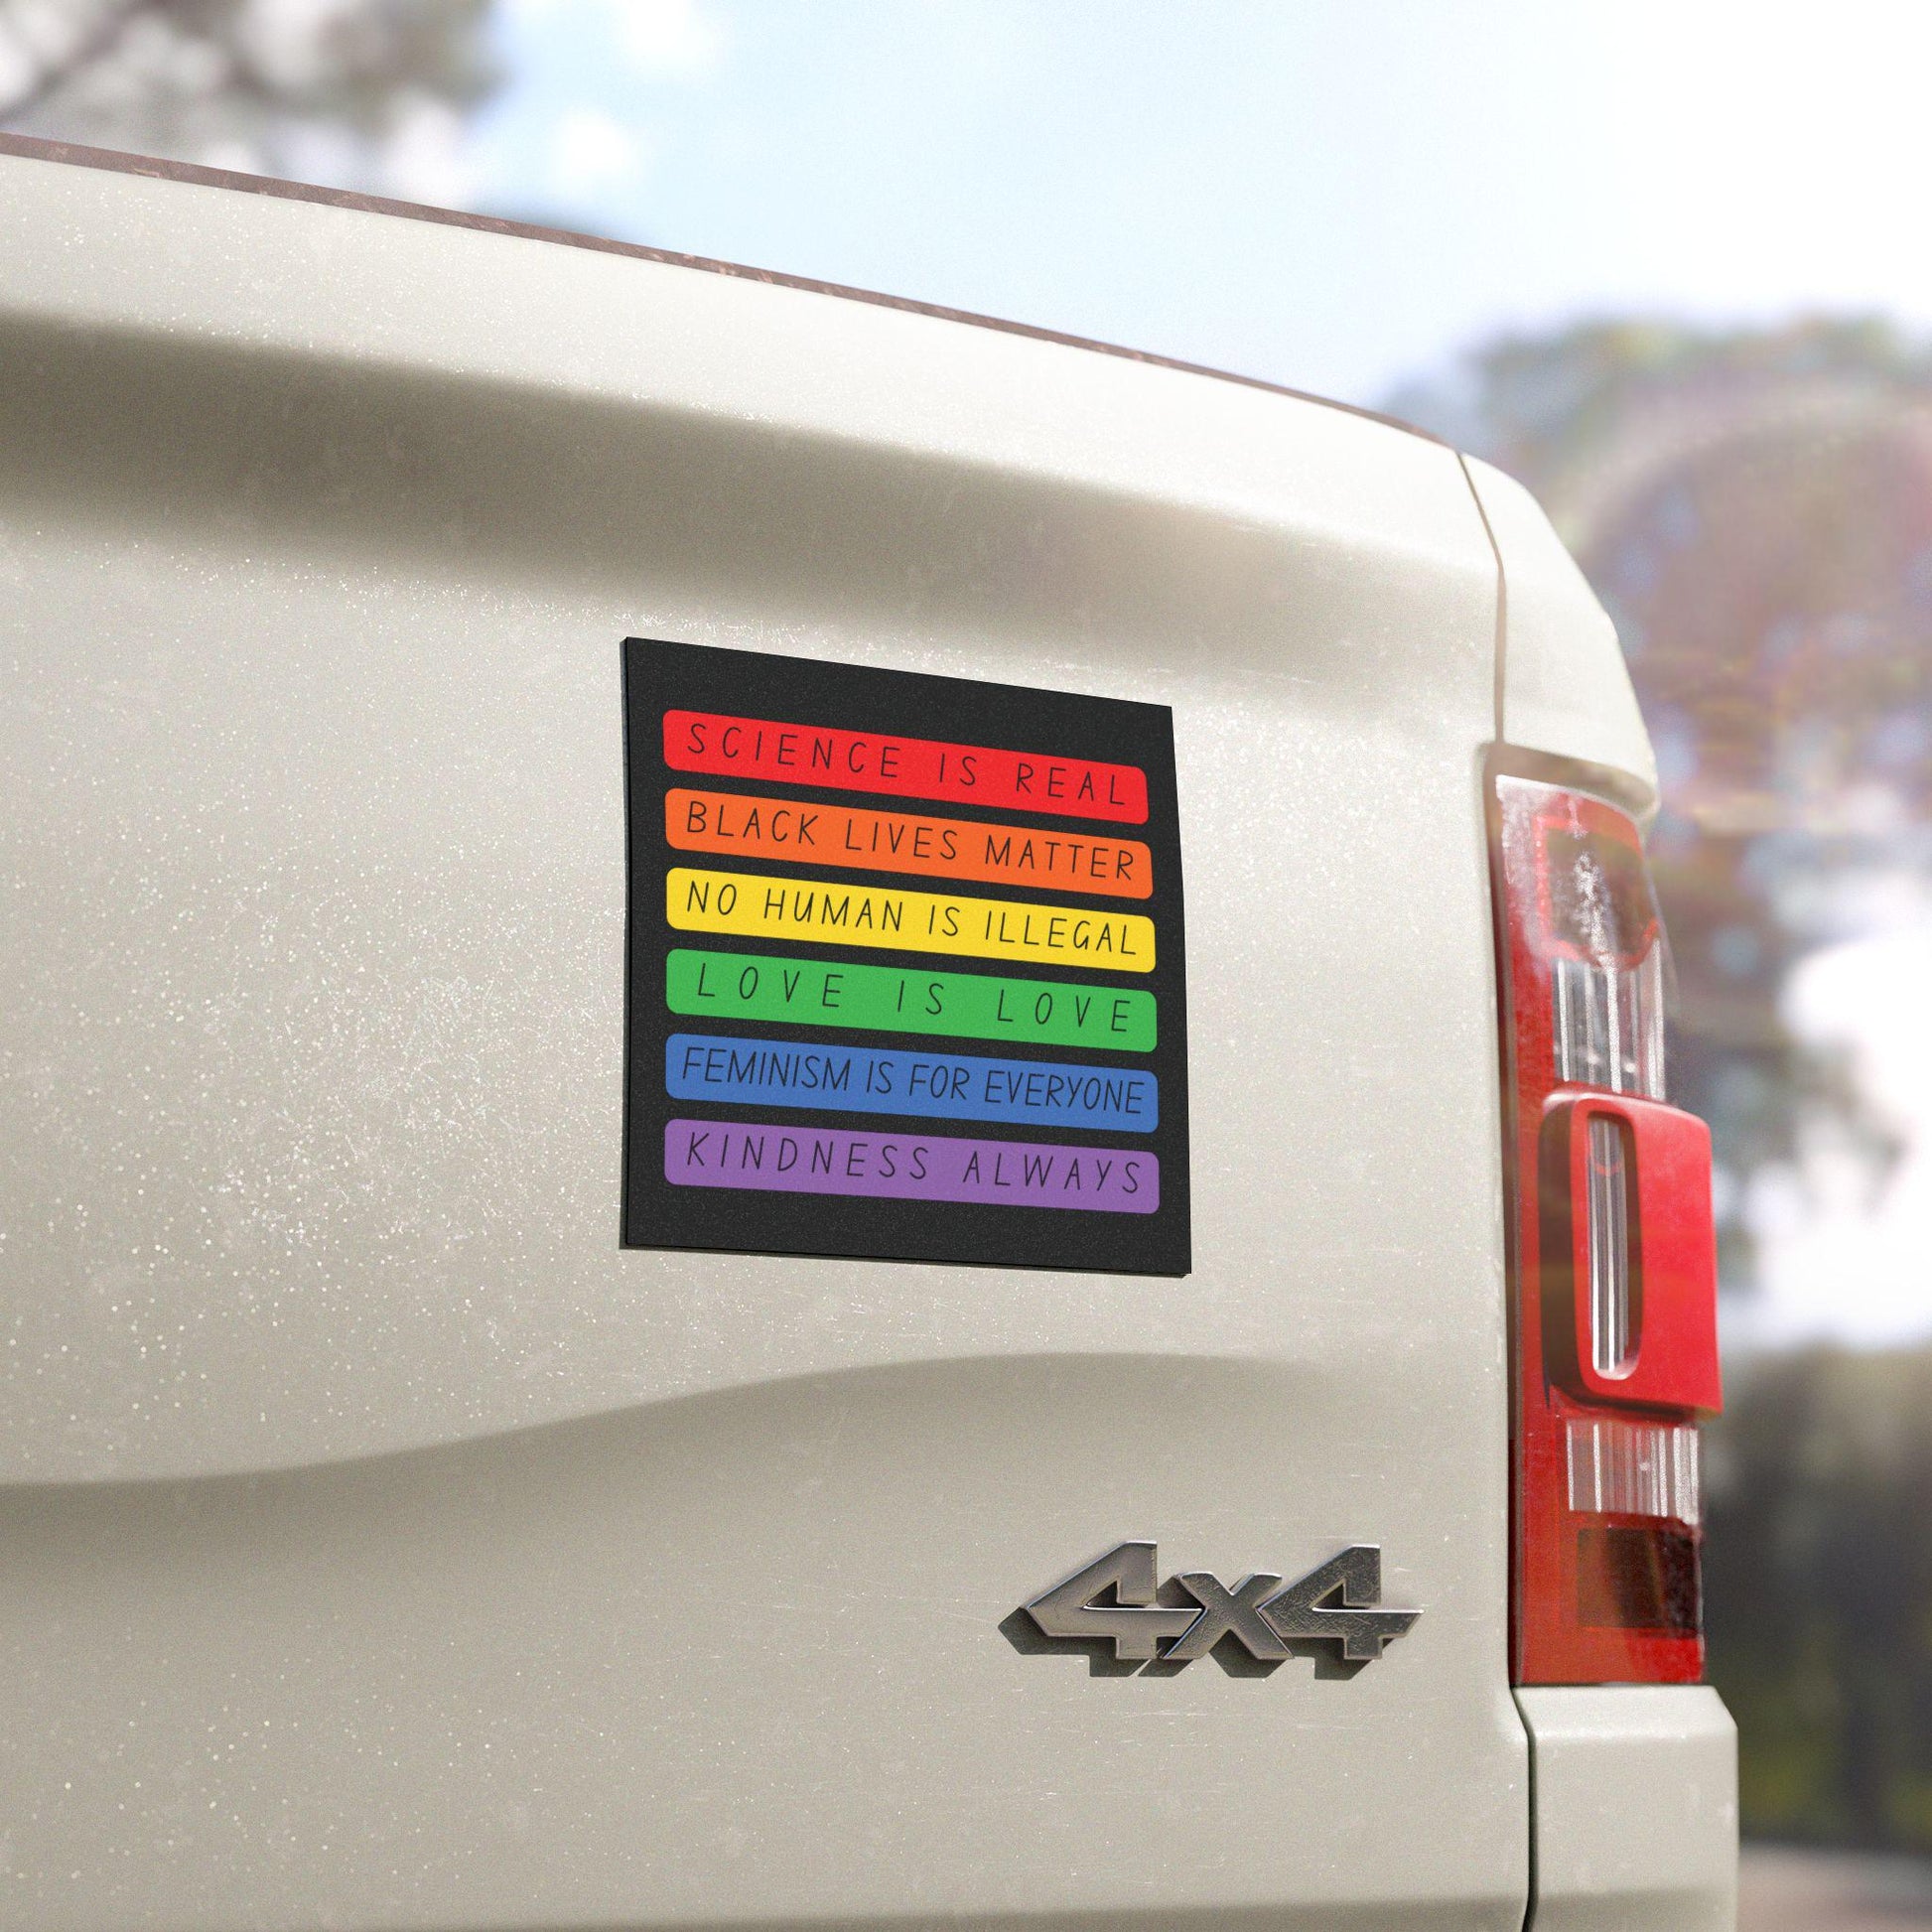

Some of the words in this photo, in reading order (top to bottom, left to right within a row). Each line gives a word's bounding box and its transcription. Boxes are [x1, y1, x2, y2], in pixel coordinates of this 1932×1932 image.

[687, 723, 900, 778] SCIENCE
[940, 753, 977, 786] IS
[1016, 762, 1126, 806] REAL
[686, 801, 819, 844] BLACK
[845, 819, 957, 860] LIVES
[985, 834, 1134, 881] MATTER
[686, 881, 738, 916] NO
[764, 888, 902, 932] HUMAN
[928, 904, 960, 937] IS
[985, 910, 1137, 955] ILLEGAL
[698, 963, 844, 1008] LOVE
[897, 980, 944, 1016] IS
[997, 989, 1131, 1032] LOVE
[683, 1047, 851, 1091] FEMINISM
[866, 1060, 895, 1094] IS
[908, 1064, 971, 1100] FOR
[985, 1069, 1145, 1114] EVERYONE
[686, 1133, 929, 1180] KINDNESS
[963, 1151, 1140, 1194] ALWAYS
[1026, 1540, 1425, 1660] 4x4
